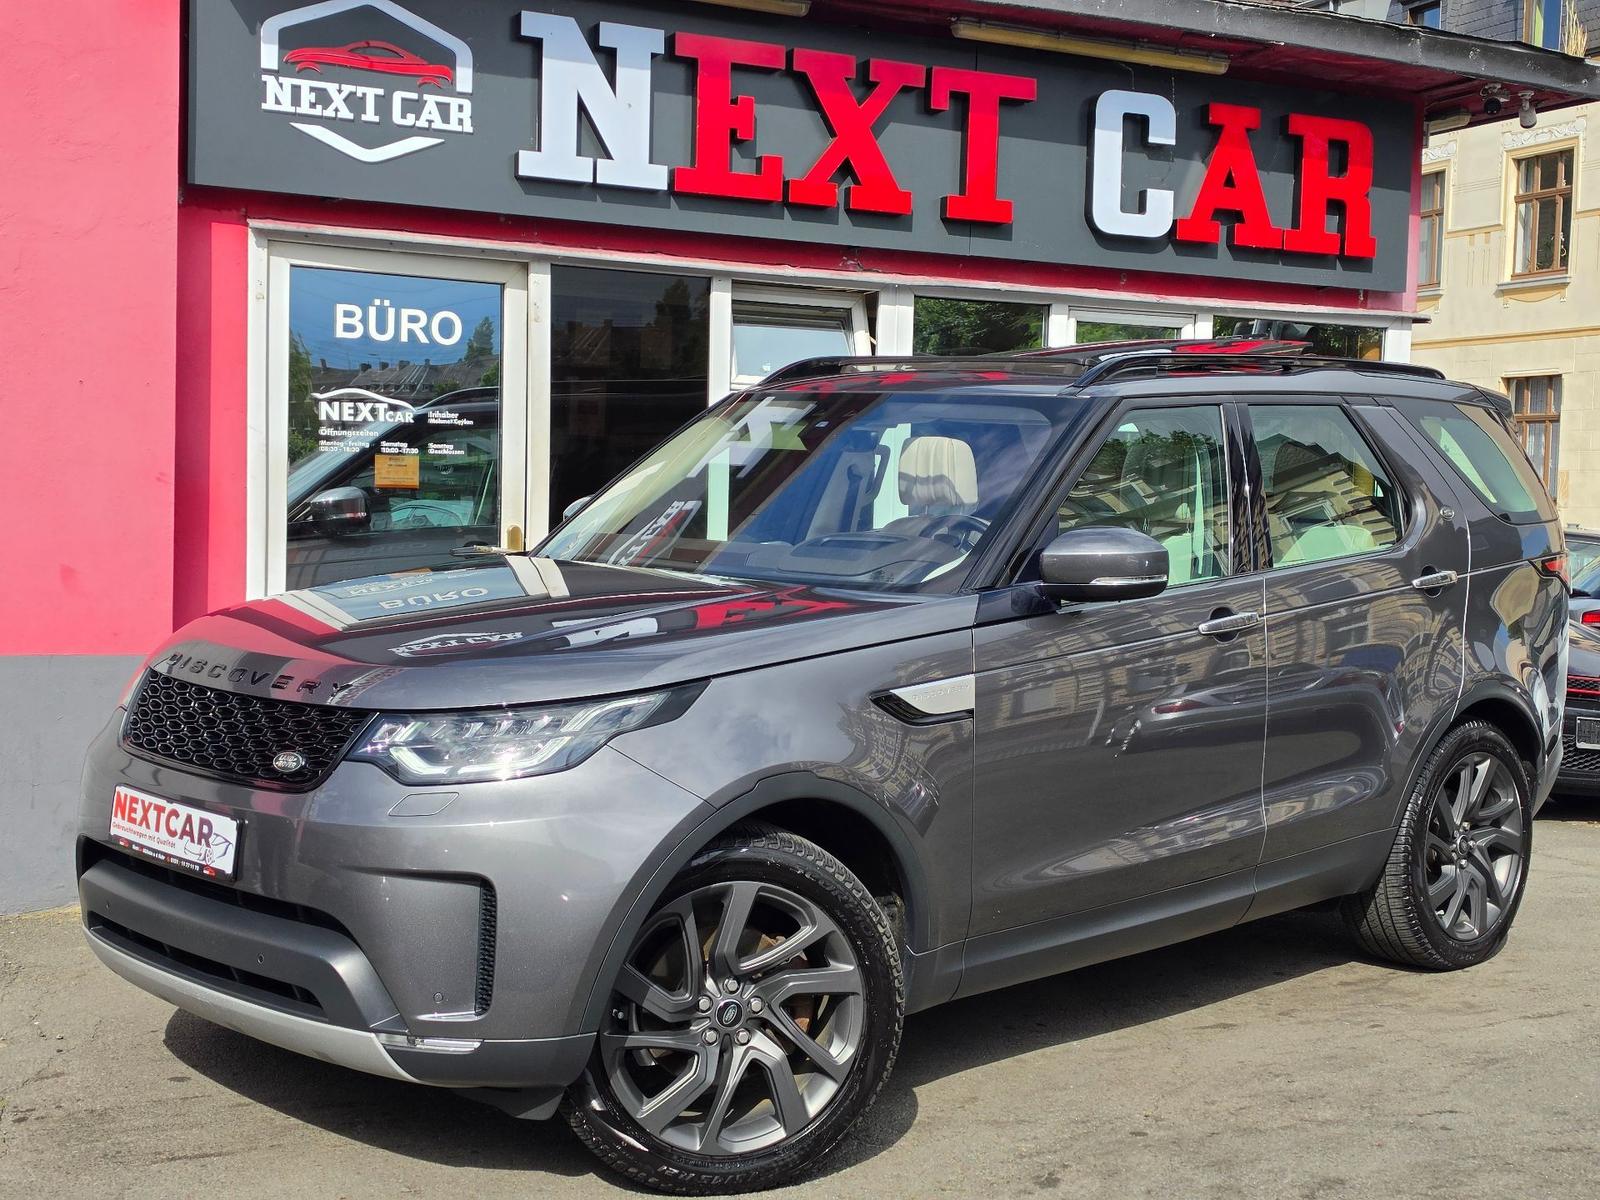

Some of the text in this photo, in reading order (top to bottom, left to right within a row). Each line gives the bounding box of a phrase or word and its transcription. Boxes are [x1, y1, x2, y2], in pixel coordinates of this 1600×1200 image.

[261, 74, 473, 133] NEXT CAR
[518, 10, 1377, 258] NEXT CAR
[335, 298, 462, 345] BÜRO
[318, 426, 379, 438] Öffnungszeiten
[319, 401, 414, 423] NEXT CAR
[113, 790, 212, 848] NEXTCAR
